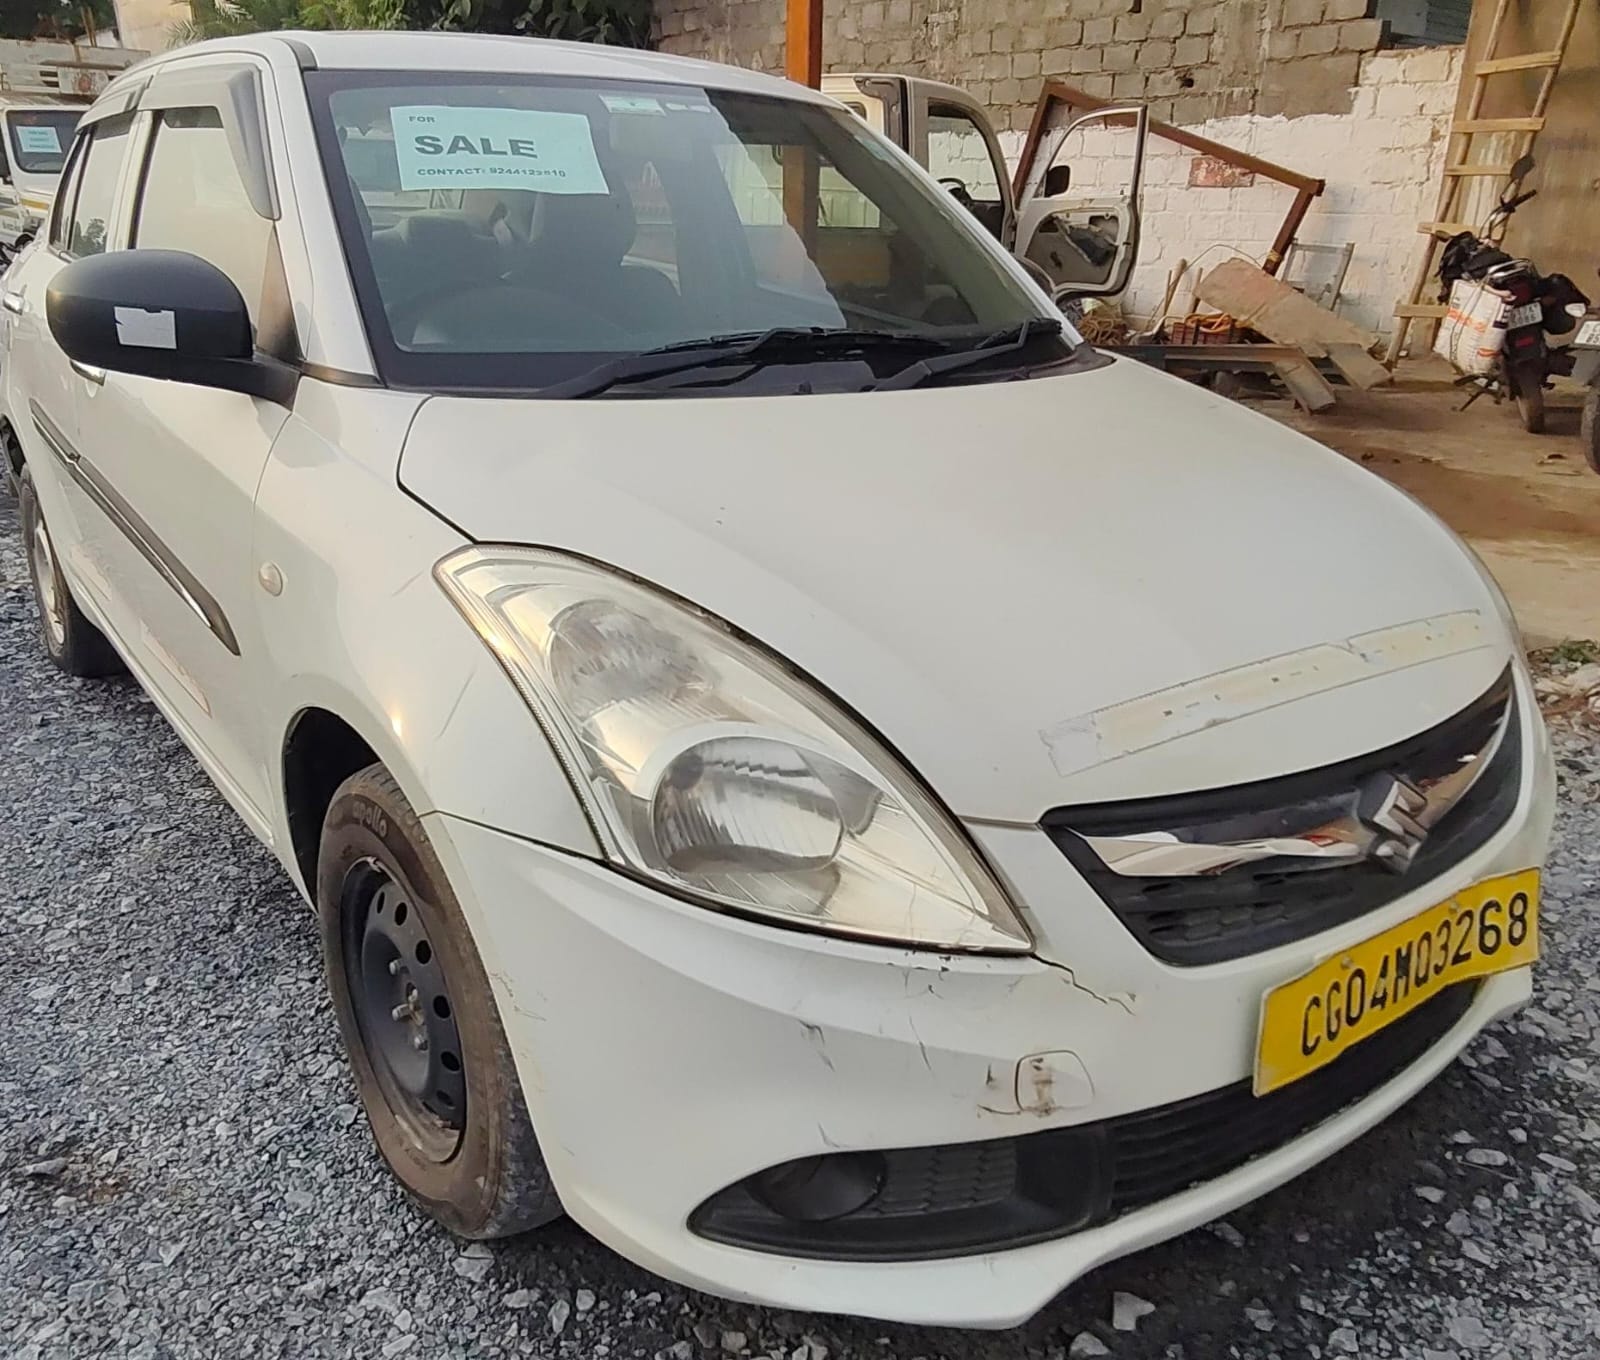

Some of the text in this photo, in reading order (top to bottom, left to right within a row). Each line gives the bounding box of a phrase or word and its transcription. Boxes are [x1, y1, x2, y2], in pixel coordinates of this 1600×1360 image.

[409, 115, 436, 123] FOR
[414, 134, 539, 160] SALE
[417, 168, 486, 176] CONTACT:
